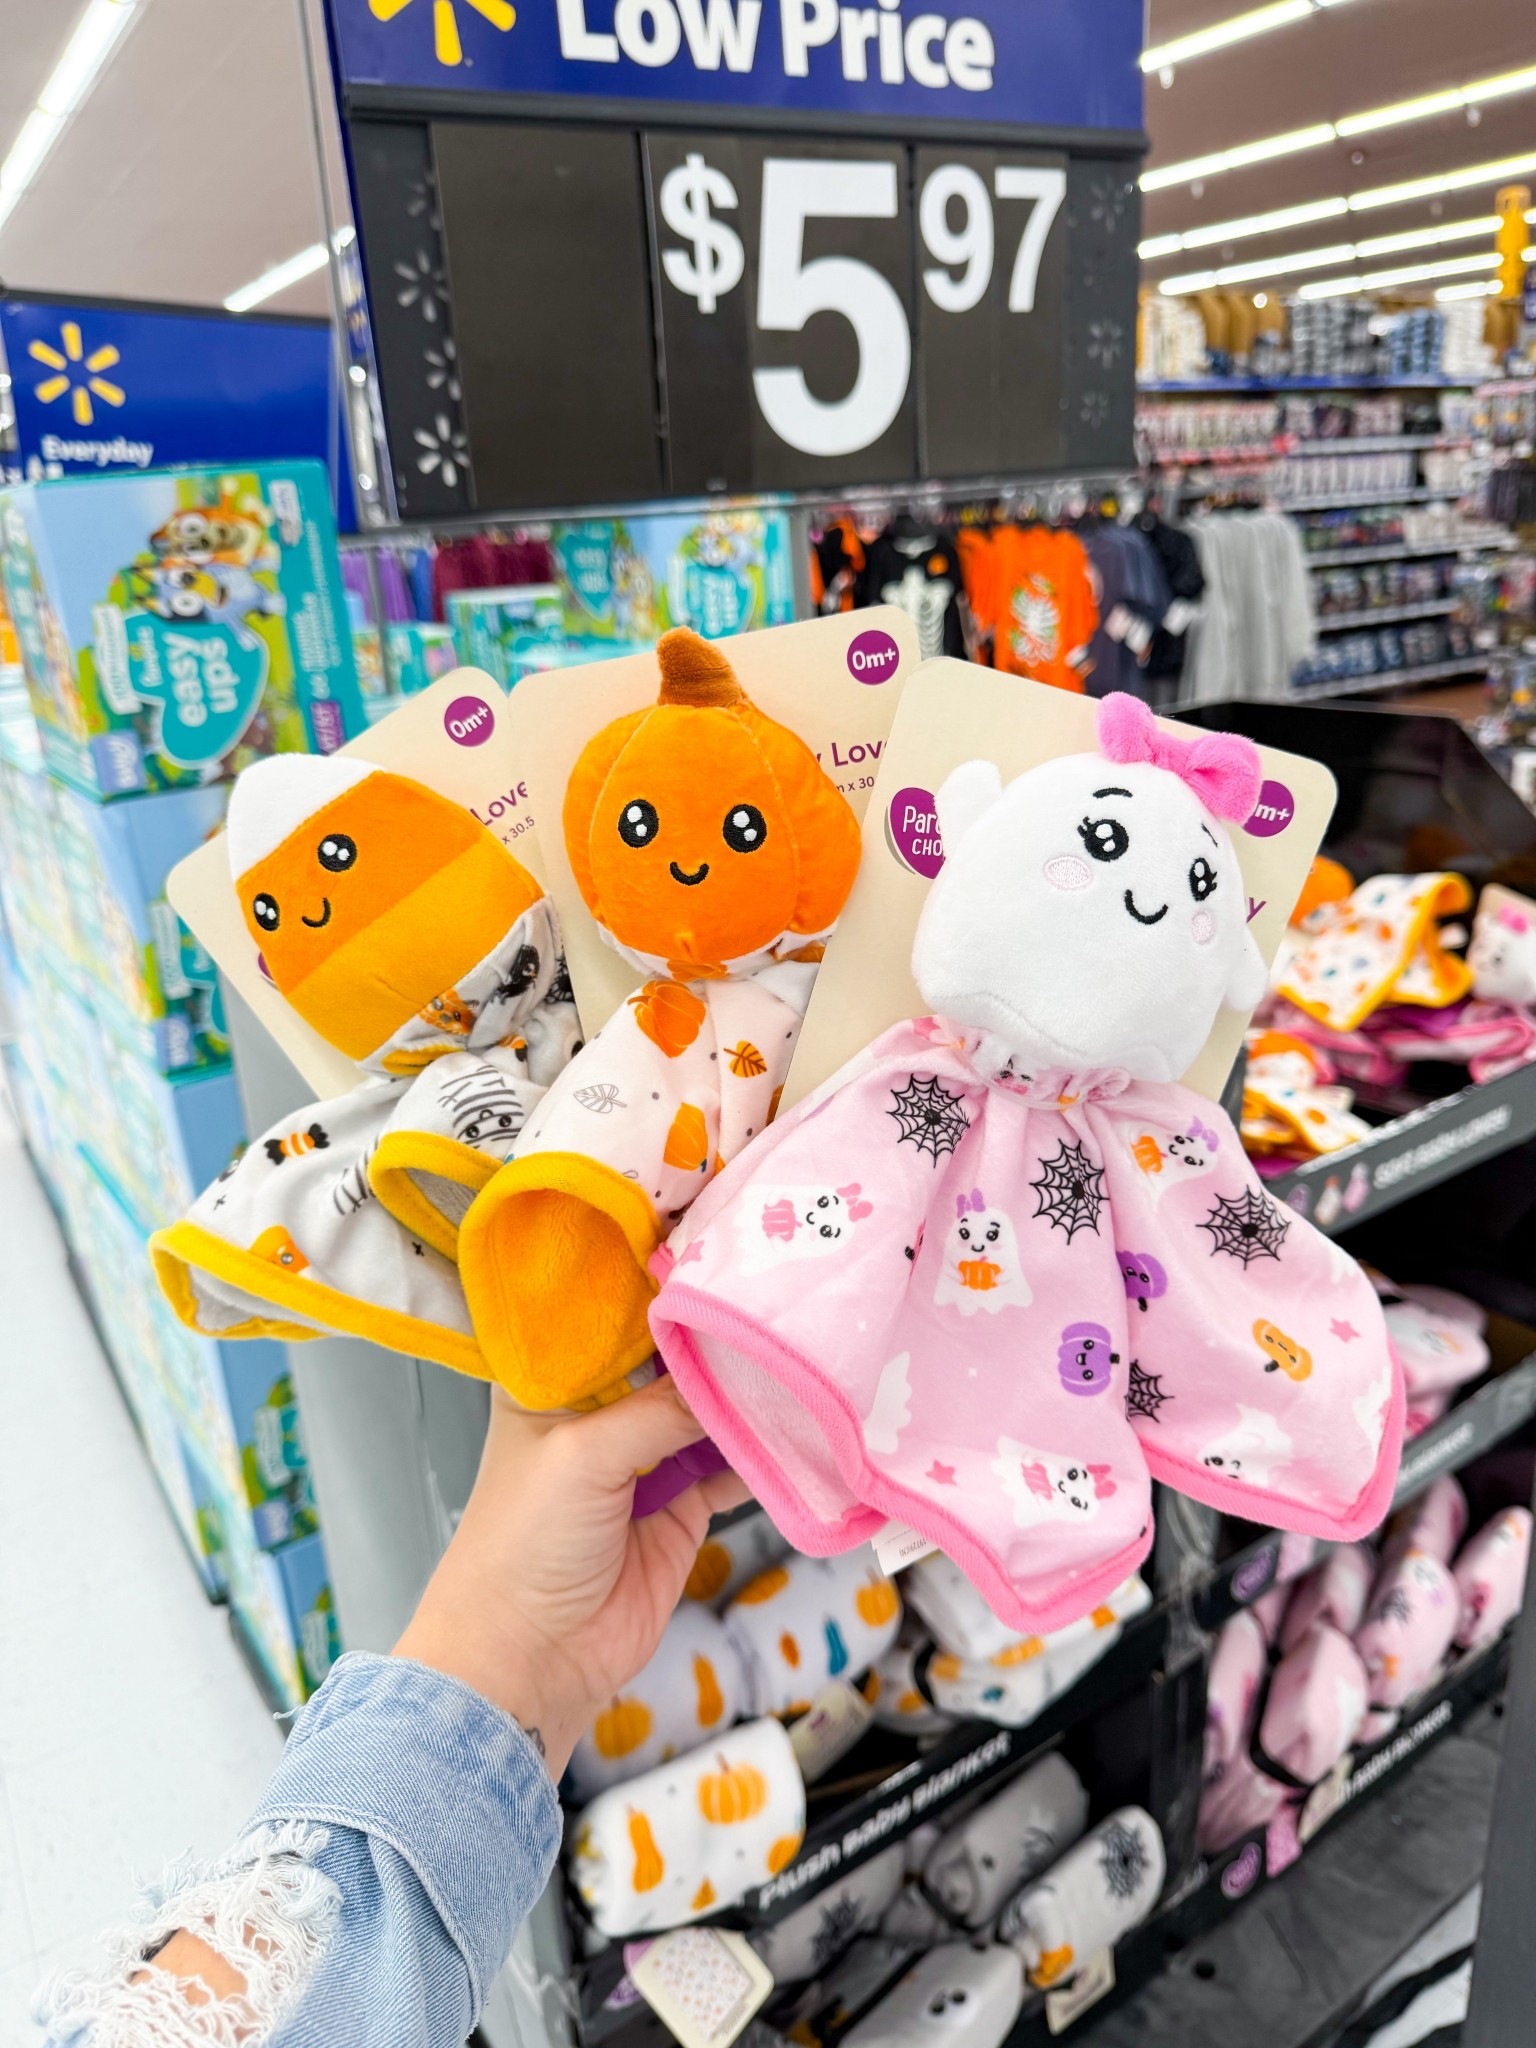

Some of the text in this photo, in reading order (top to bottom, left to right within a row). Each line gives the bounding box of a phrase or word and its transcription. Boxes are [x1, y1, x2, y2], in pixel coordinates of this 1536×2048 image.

[558, 0, 995, 91] Low Price
[40, 433, 154, 468] Everyday
[200, 636, 240, 713] ups
[851, 648, 896, 672] 0m+
[162, 631, 208, 727] easy
[450, 705, 488, 738] 0m+
[831, 740, 888, 767] Lov
[1254, 803, 1290, 822] m+
[911, 838, 944, 857] CHO
